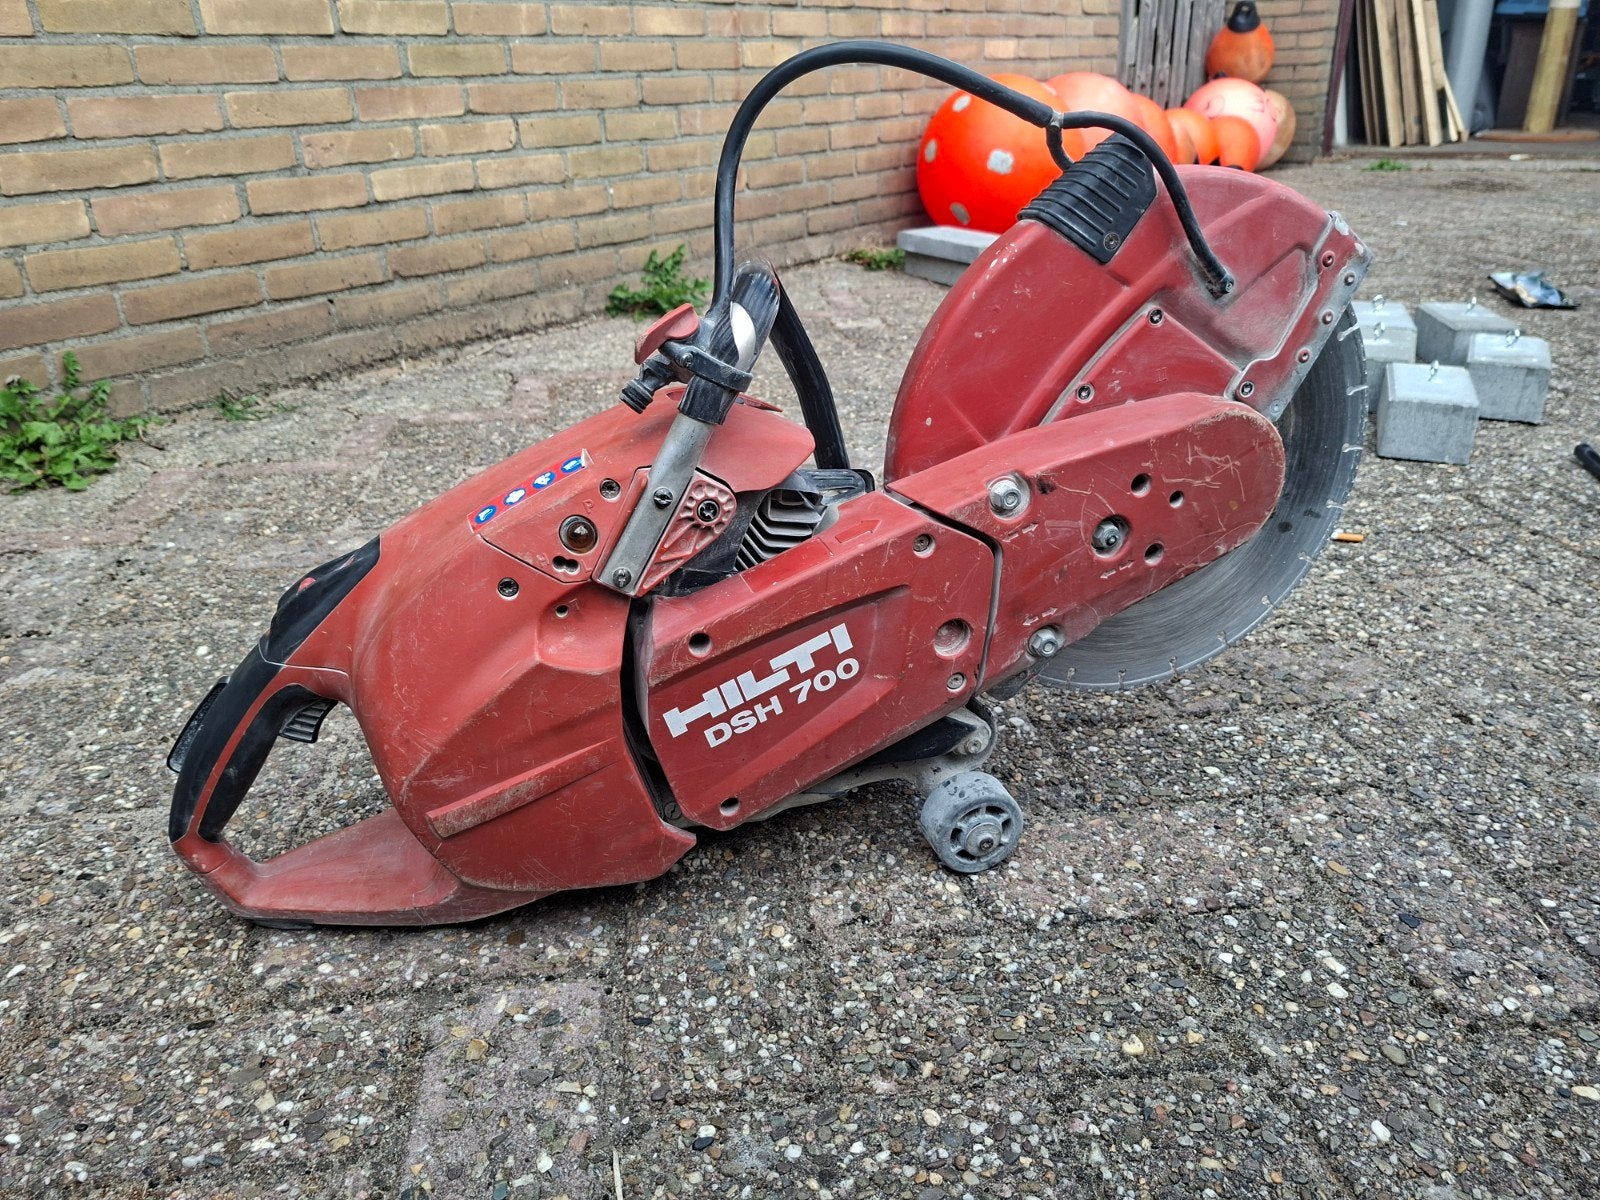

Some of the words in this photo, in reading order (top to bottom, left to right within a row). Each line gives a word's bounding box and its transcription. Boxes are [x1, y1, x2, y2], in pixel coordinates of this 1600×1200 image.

[662, 622, 854, 739] HILTI
[703, 694, 784, 749] DSH
[788, 657, 860, 704] 700
